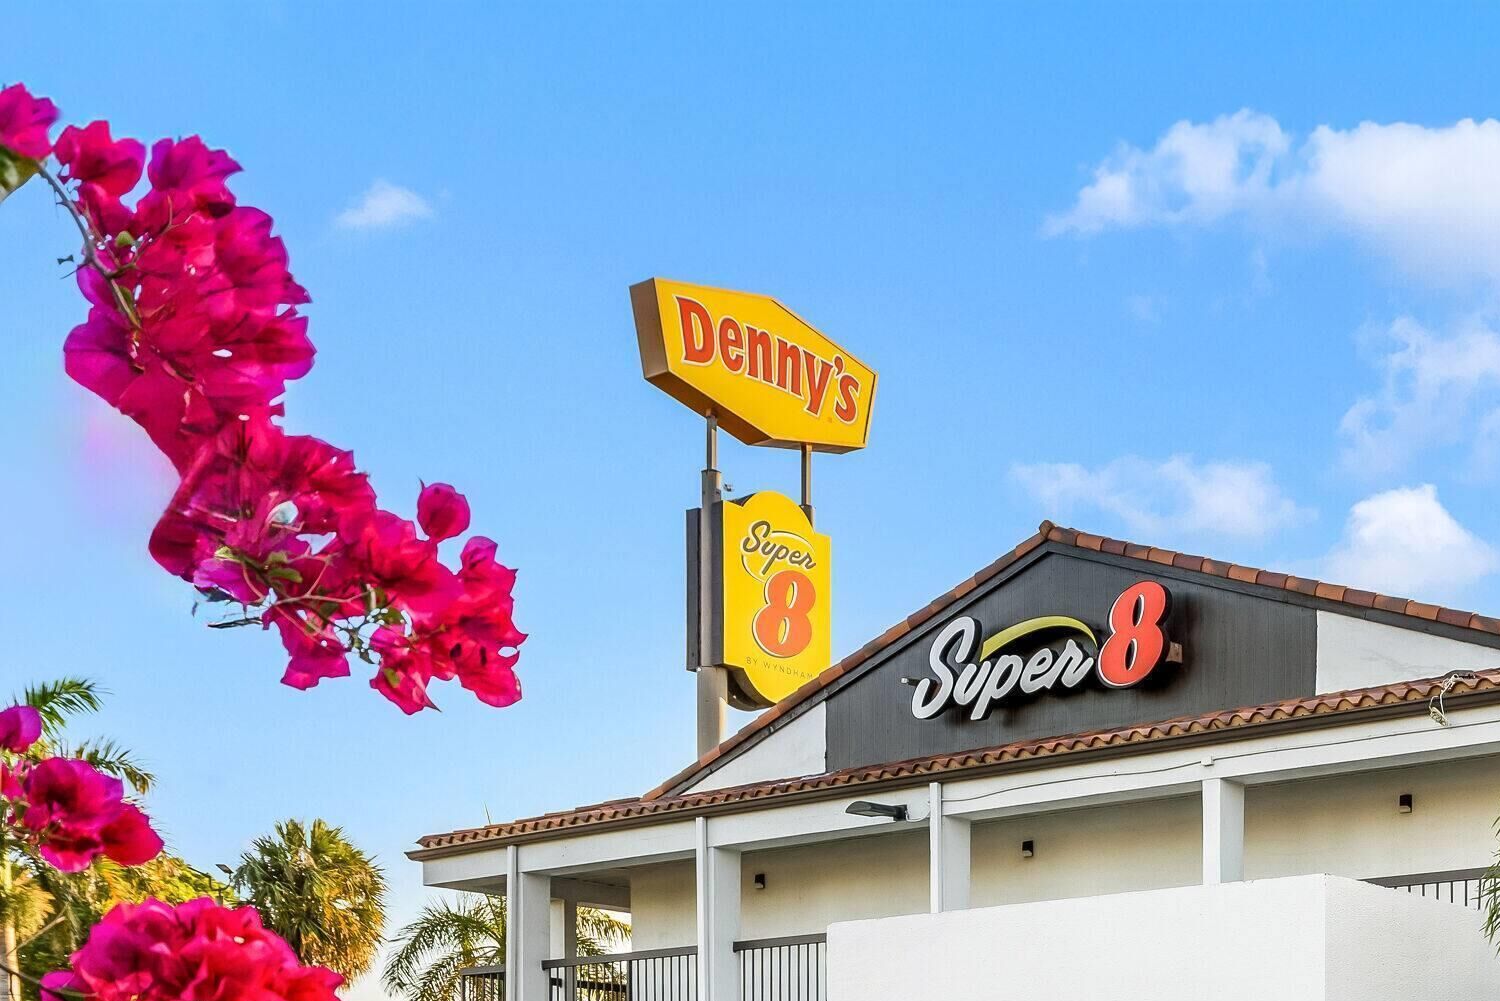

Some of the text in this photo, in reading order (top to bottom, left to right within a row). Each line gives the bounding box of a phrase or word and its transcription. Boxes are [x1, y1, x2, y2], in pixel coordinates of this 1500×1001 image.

[673, 294, 861, 424] Denny's
[742, 520, 817, 576] Super
[752, 569, 817, 658] 8
[911, 580, 1169, 721] Super 8
[746, 656, 813, 680] BY WYNDHAM
